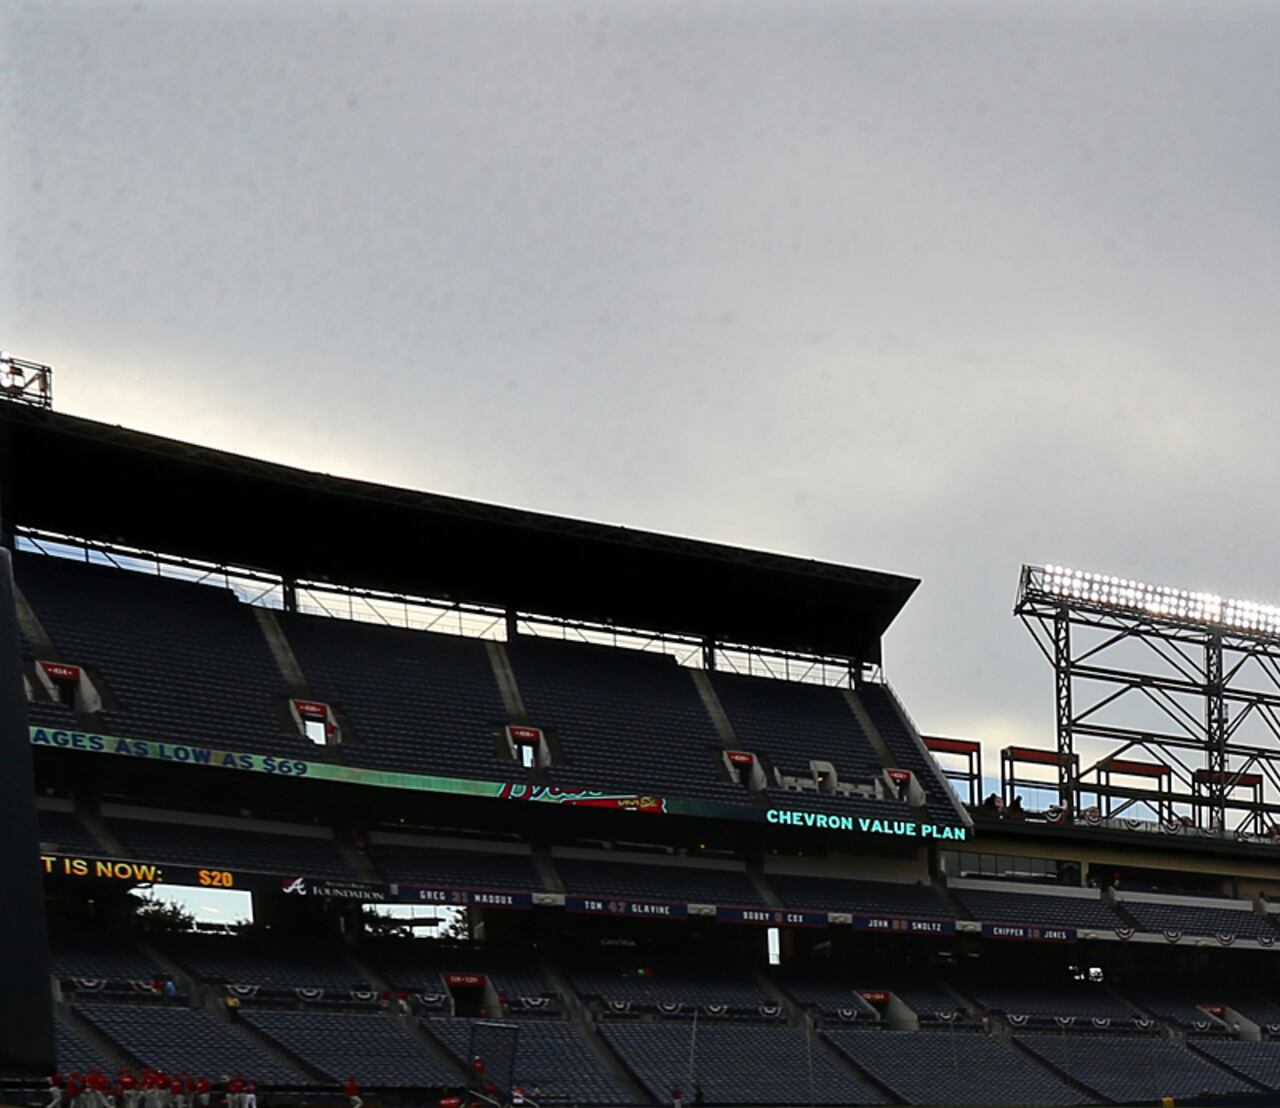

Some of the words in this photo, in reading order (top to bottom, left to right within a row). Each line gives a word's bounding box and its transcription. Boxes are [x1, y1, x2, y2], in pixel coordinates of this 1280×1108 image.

[115, 738, 148, 757] AS
[159, 744, 212, 765] LOW
[222, 752, 253, 769] AS
[262, 756, 308, 776] $69
[766, 808, 853, 830] CHEVRON
[858, 817, 918, 837] VALUE
[920, 823, 966, 841] PLAN
[63, 857, 89, 876] IS
[95, 860, 163, 882] NOW:
[197, 868, 234, 888] $20
[312, 885, 386, 902] FOUNDATION
[419, 890, 446, 901] GREG
[631, 904, 671, 915] GLAVINE
